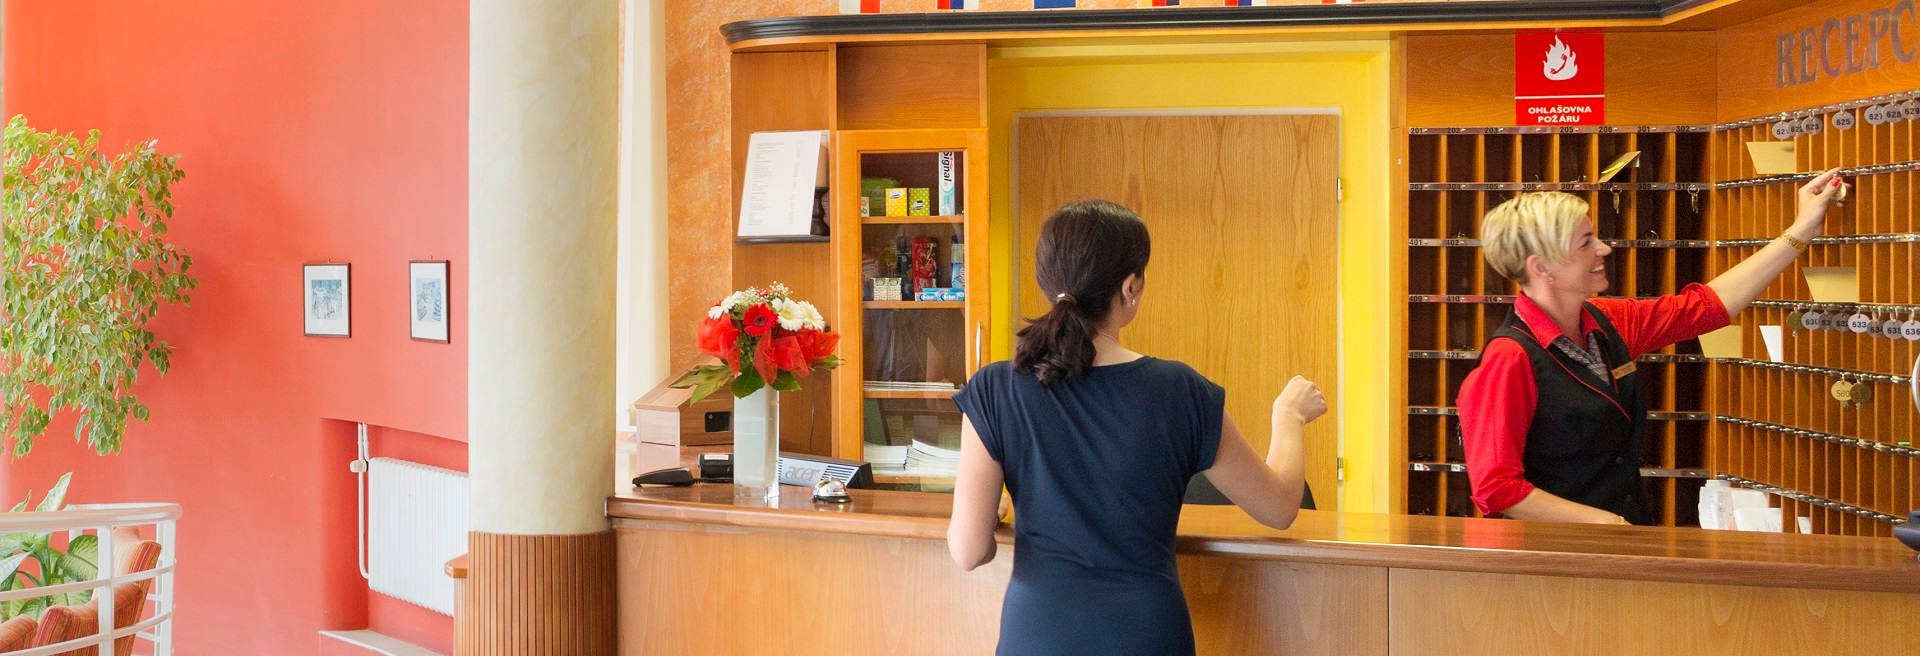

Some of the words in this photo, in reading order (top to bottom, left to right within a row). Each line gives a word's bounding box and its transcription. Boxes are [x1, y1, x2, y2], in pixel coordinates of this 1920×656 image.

[1528, 105, 1592, 114] OHLAŠOVNA
[1538, 114, 1580, 123] POŽÁRU
[941, 152, 952, 182] Signal
[785, 466, 820, 481] acer
